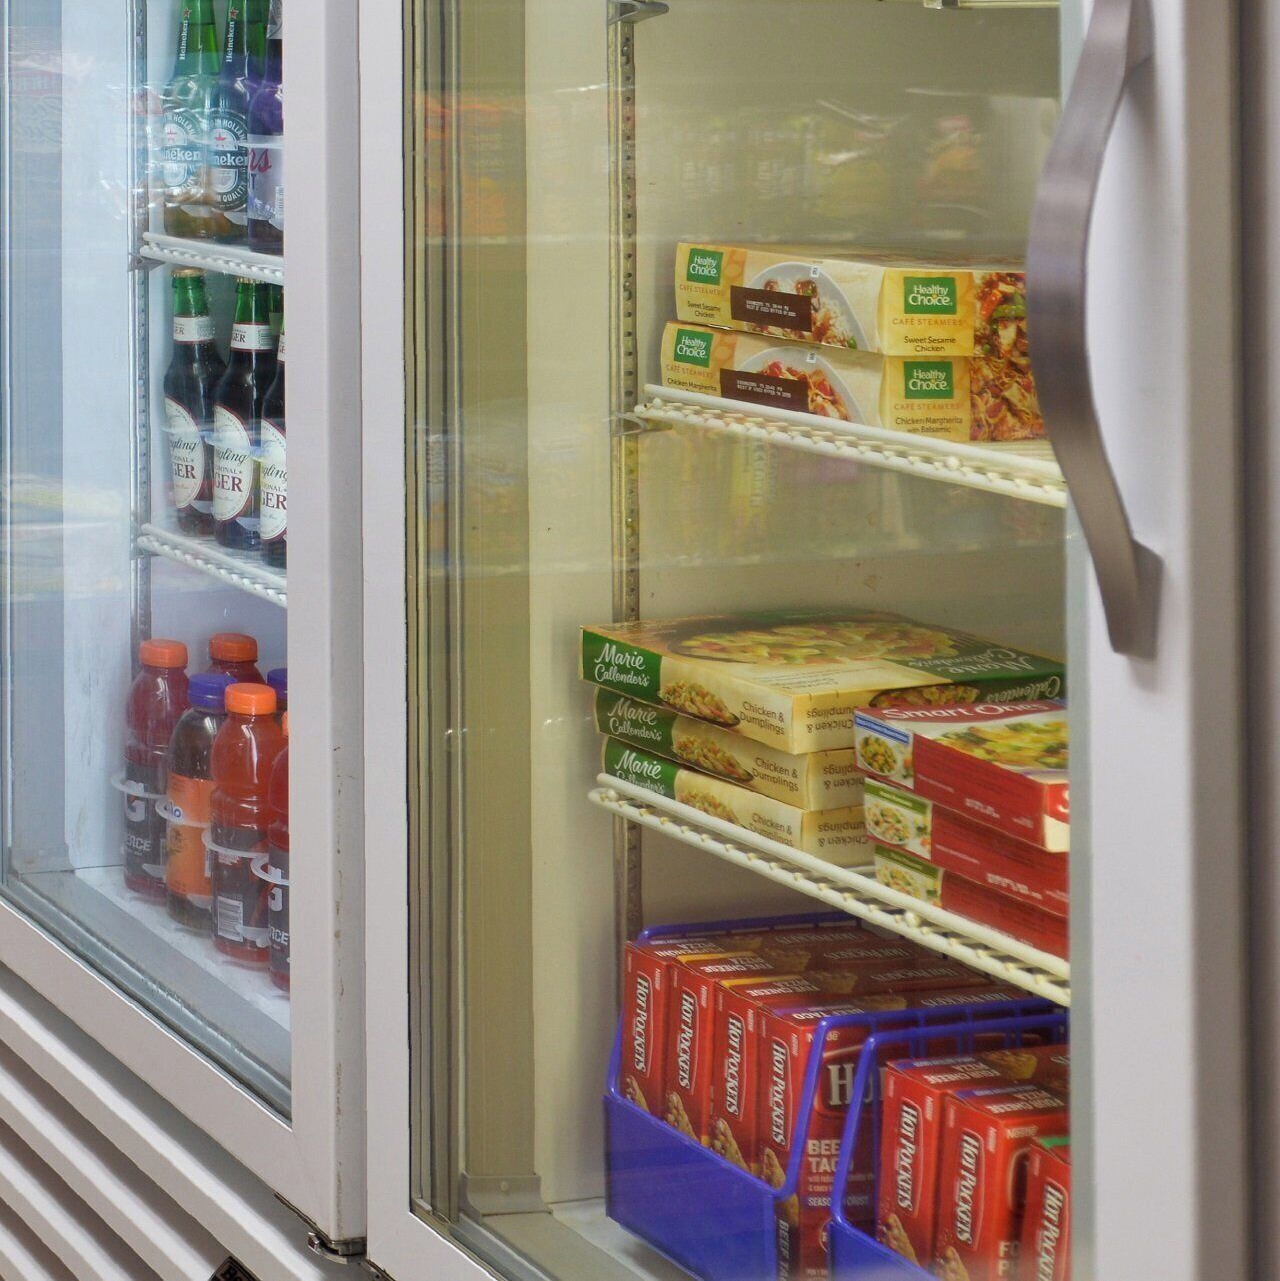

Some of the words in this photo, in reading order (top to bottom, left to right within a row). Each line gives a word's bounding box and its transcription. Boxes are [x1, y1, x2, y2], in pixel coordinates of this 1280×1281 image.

[179, 20, 188, 60] Heineken
[226, 21, 235, 62] Heineken
[695, 256, 717, 269] Healthy
[908, 292, 950, 307] Choice
[913, 284, 949, 299] Healthy
[918, 318, 962, 327] STEAMERS
[903, 335, 926, 346] Sweet
[927, 336, 957, 346] Sesame
[914, 343, 946, 353] Chicken
[908, 376, 949, 390] Choice
[913, 369, 947, 383] Healthy
[895, 416, 923, 425] Chicken
[924, 416, 963, 427] Margherita
[599, 641, 646, 670] Marie
[594, 663, 650, 687] Callender's
[741, 700, 777, 722] Chicken
[777, 710, 785, 723] &
[882, 705, 967, 721] Smart
[976, 698, 1044, 716] Ones
[739, 710, 785, 736] Dumplings
[751, 767, 800, 793] Dumplings
[771, 1039, 788, 1073] HOT
[769, 1072, 787, 1146] POCKETS
[901, 1101, 919, 1136] HOT
[895, 1135, 917, 1212] POCKETS
